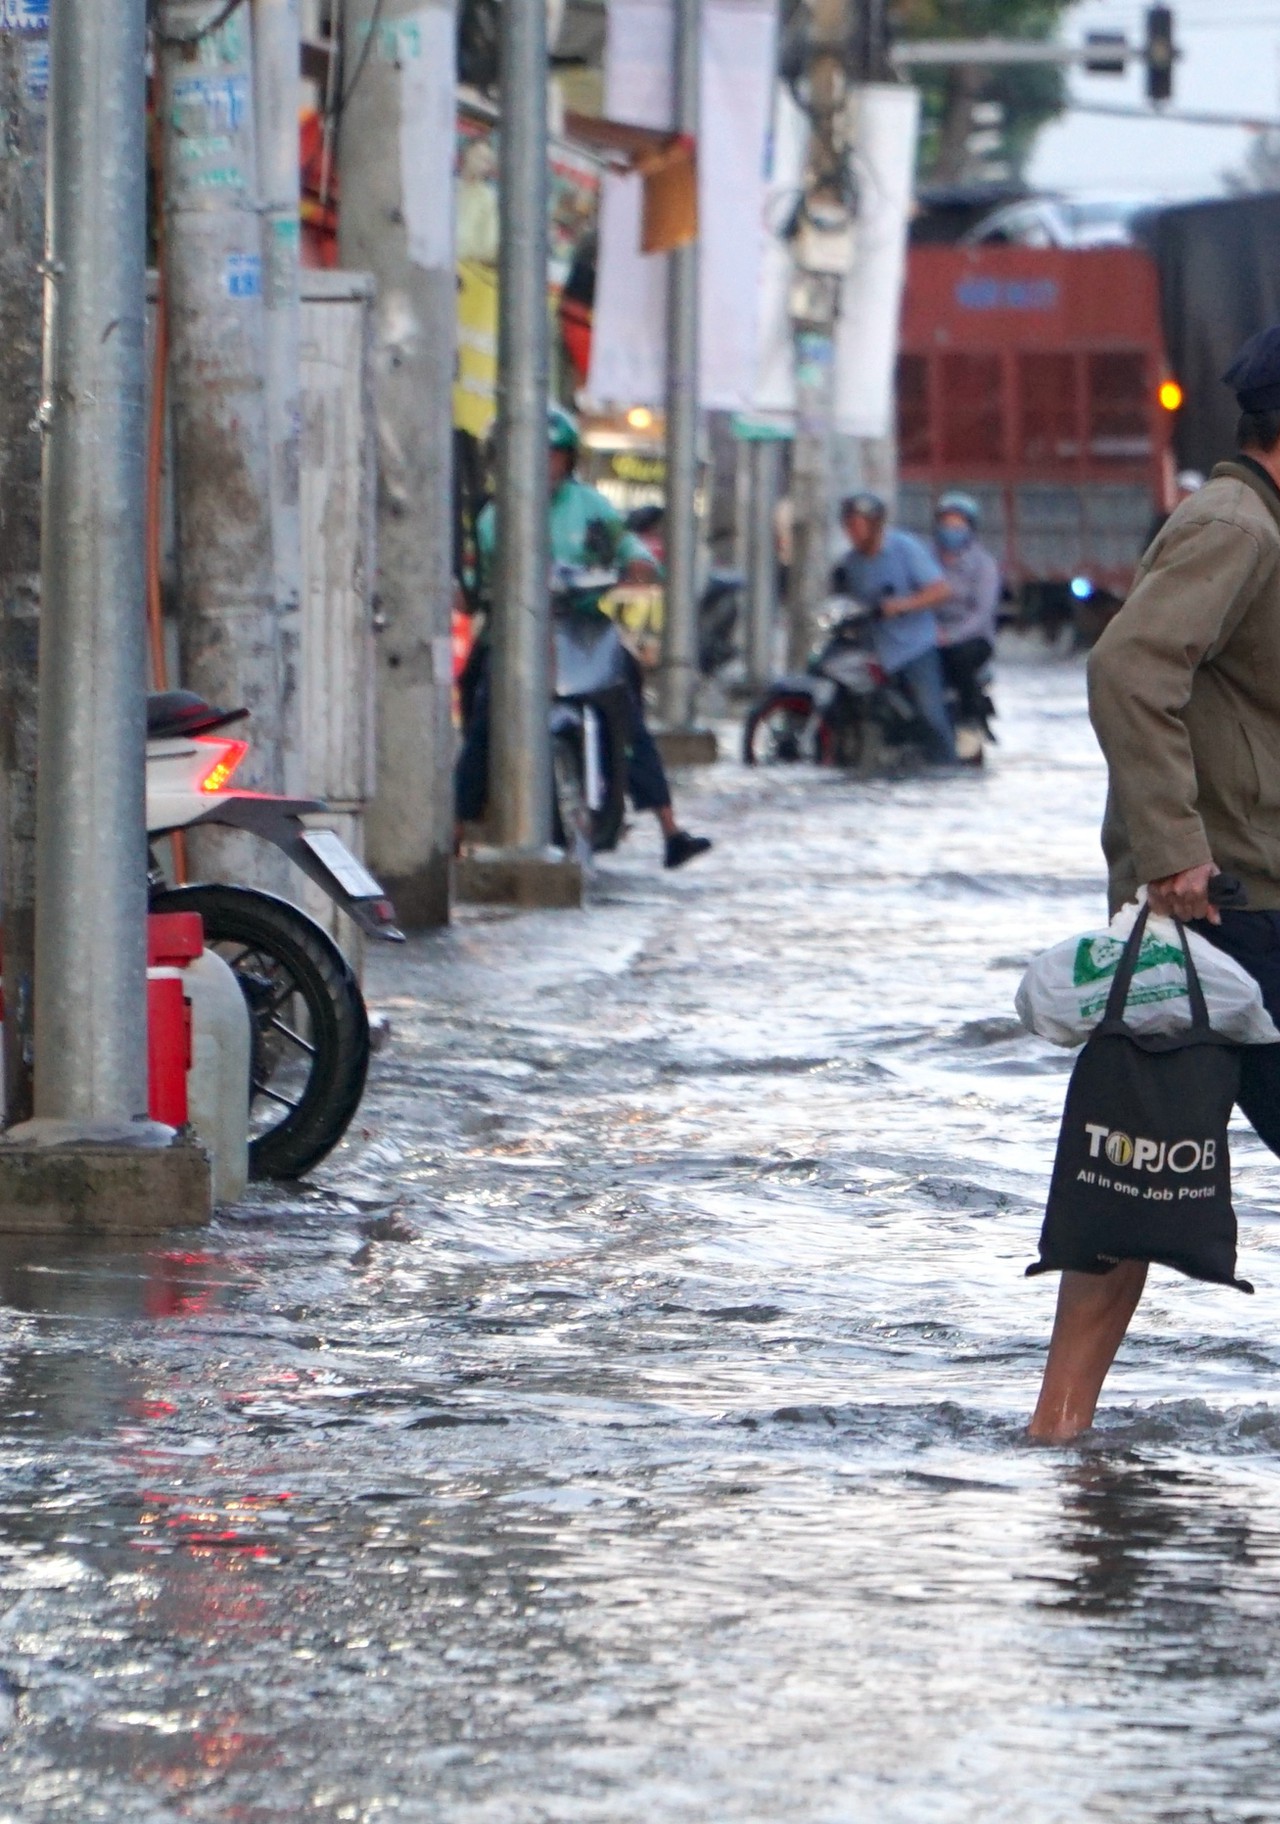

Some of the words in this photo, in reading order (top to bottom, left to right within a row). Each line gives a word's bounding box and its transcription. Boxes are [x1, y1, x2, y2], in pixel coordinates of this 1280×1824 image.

[1085, 1123, 1216, 1172] TOPJOB
[1076, 1169, 1095, 1184] All
[1098, 1174, 1111, 1189] in
[1113, 1180, 1139, 1196] one
[1142, 1187, 1174, 1201] Job
[1178, 1185, 1216, 1200] Portal
